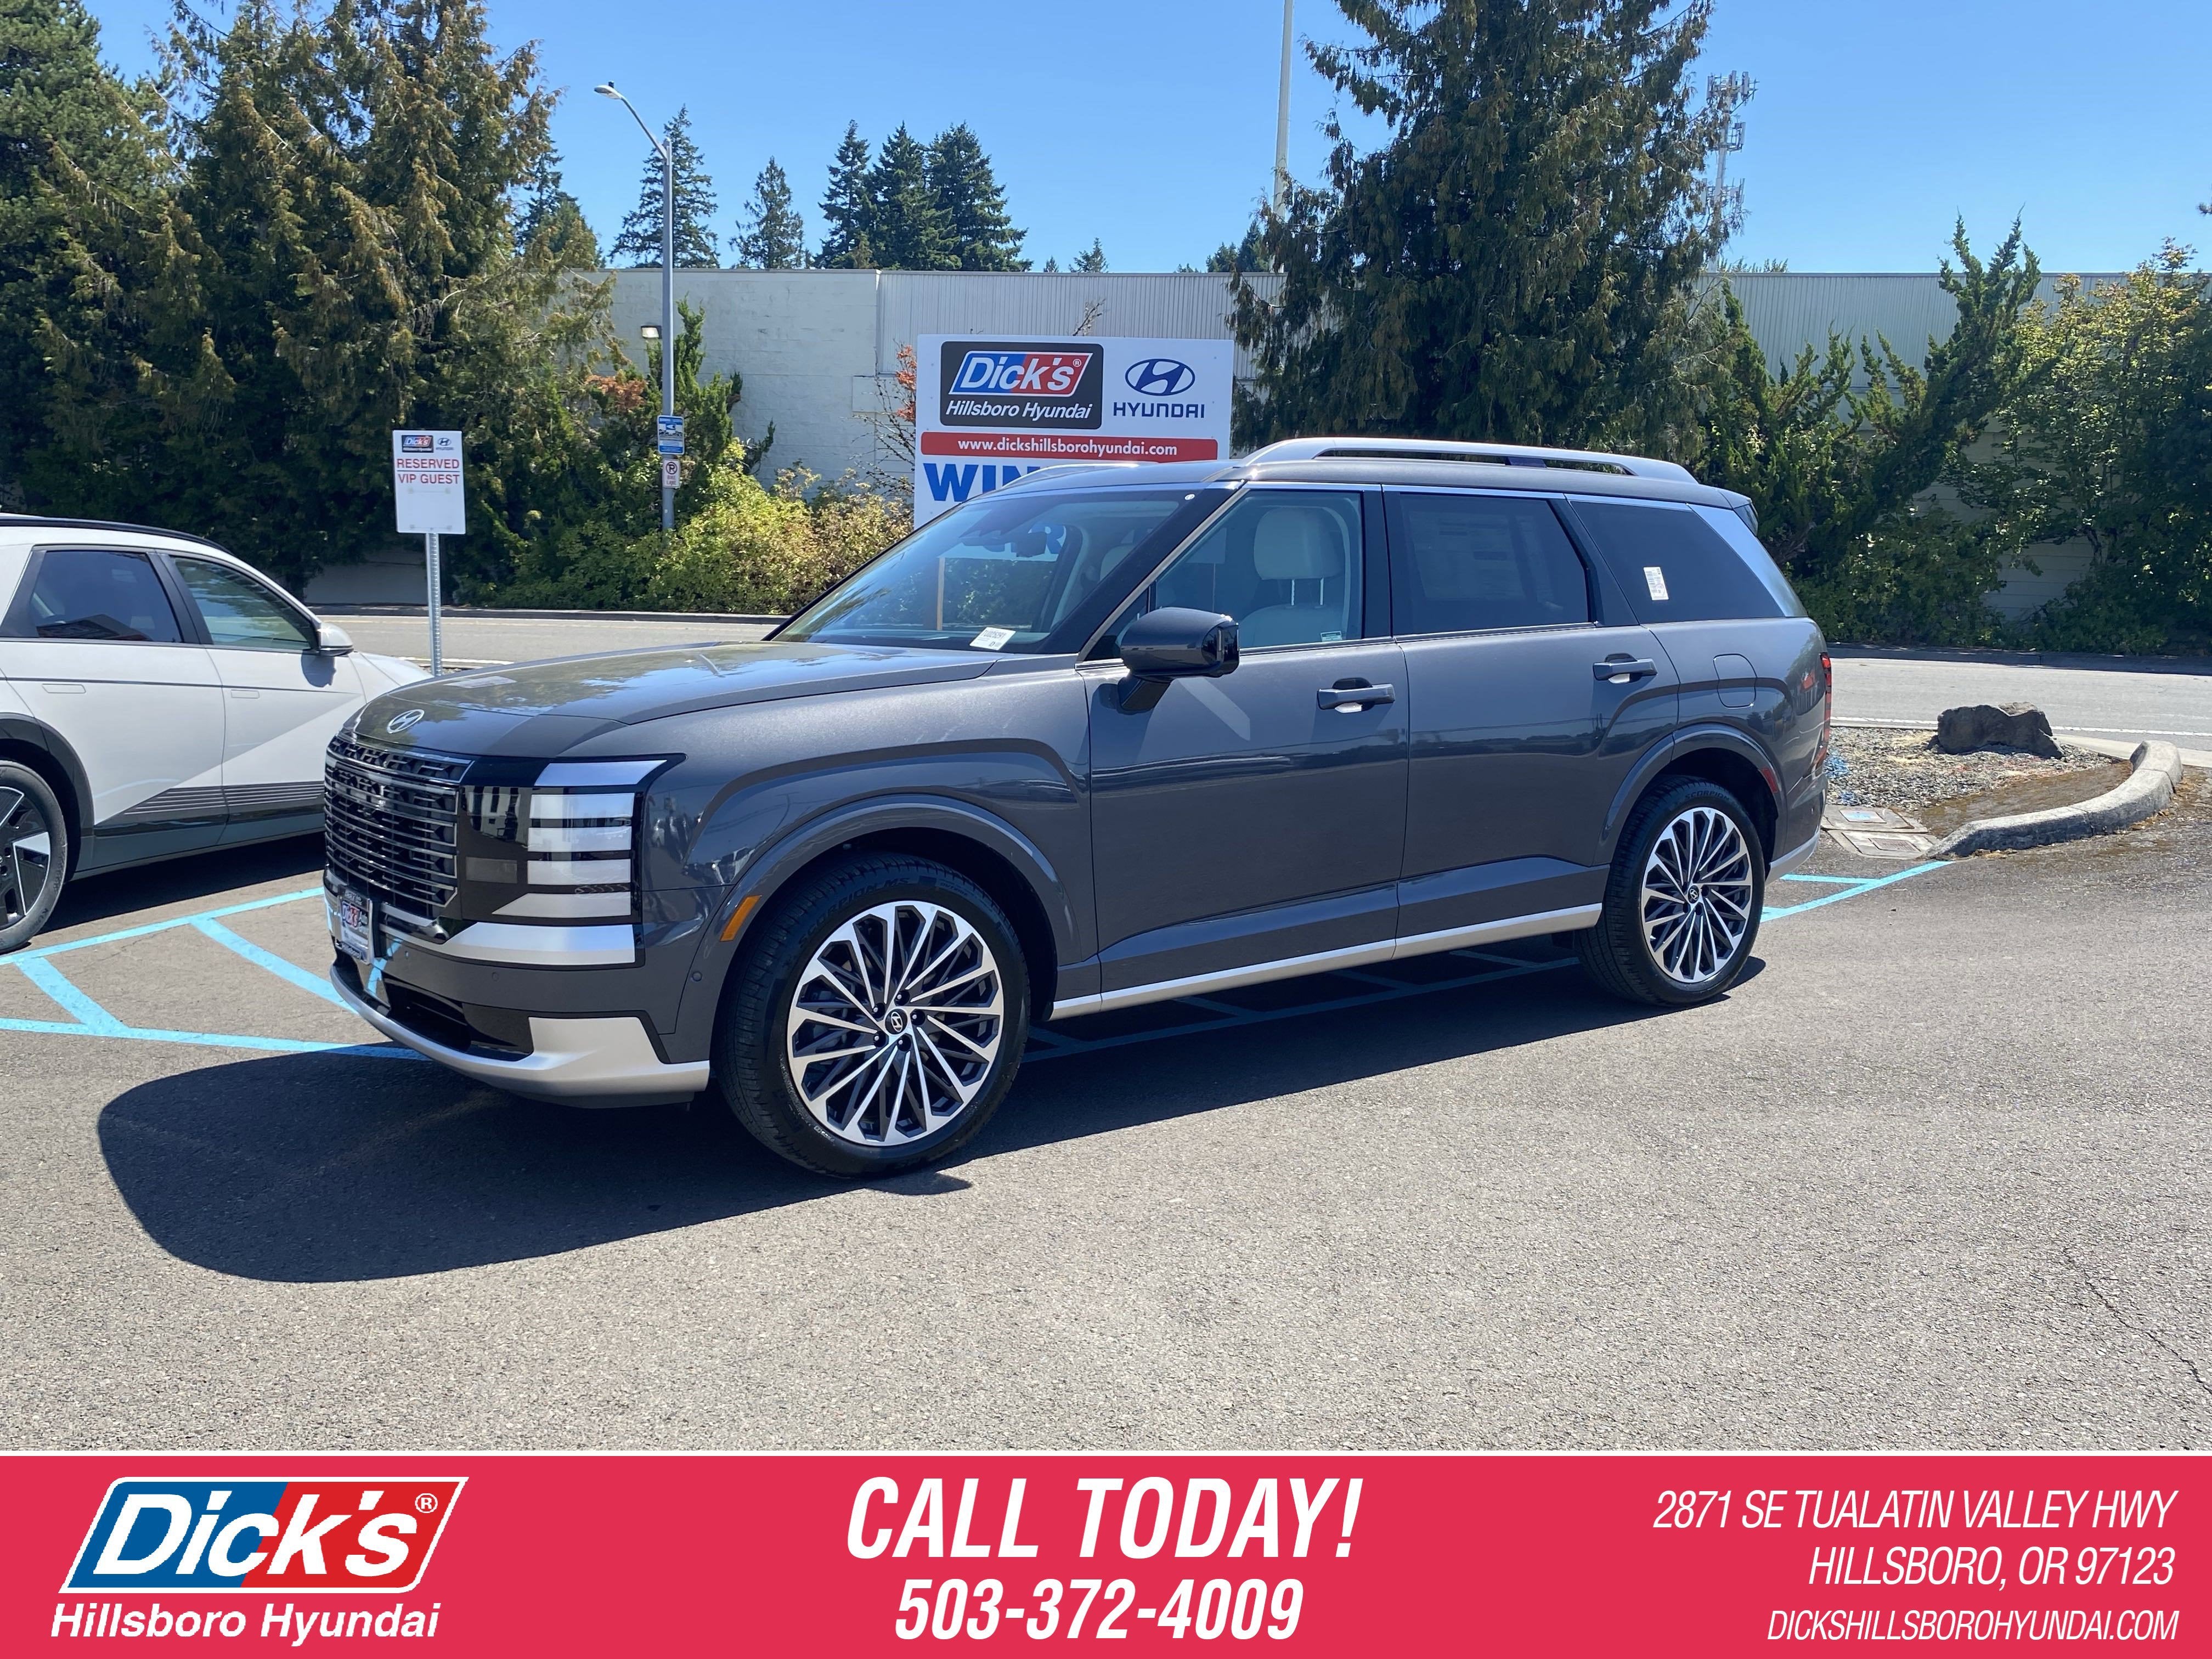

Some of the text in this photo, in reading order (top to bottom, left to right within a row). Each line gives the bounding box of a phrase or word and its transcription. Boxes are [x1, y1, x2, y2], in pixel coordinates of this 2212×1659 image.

[960, 356, 1074, 391] Dick's
[945, 400, 1093, 421] Hillsboro Hyundai
[1113, 402, 1205, 418] HYUNDAI
[958, 437, 1177, 457] www.dickshillsborohyundai.com
[397, 459, 460, 469] RESERVED
[398, 473, 460, 484] VIP GUEST
